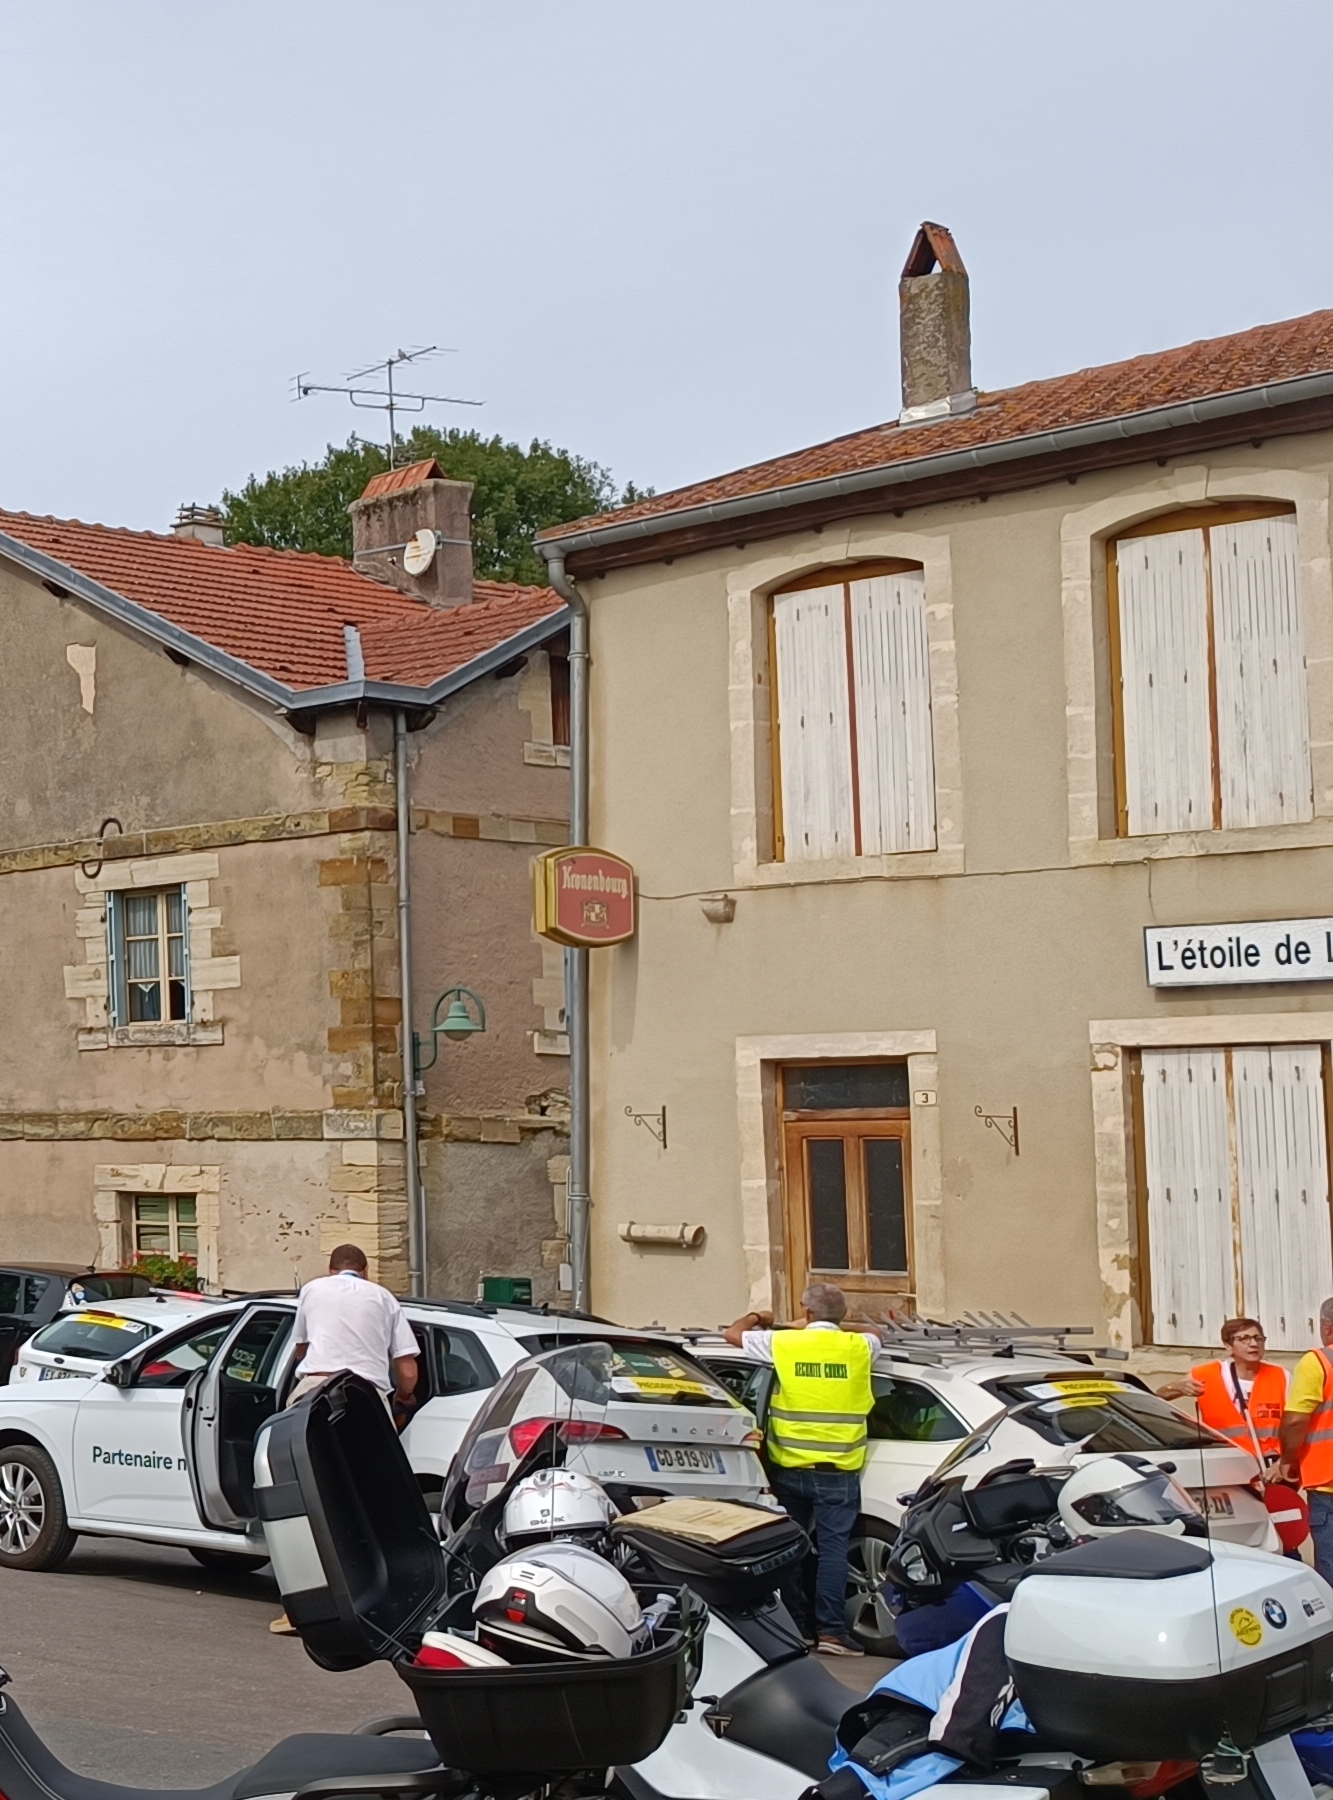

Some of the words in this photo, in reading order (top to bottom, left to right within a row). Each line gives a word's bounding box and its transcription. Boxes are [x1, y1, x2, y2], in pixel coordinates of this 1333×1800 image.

[562, 865, 628, 899] Kronenbourg
[1156, 936, 1261, 971] L'étoile
[1275, 933, 1311, 966] de
[921, 1092, 929, 1104] 3
[93, 1445, 173, 1470] Partenaire
[655, 1448, 716, 1469] GD-819-DY
